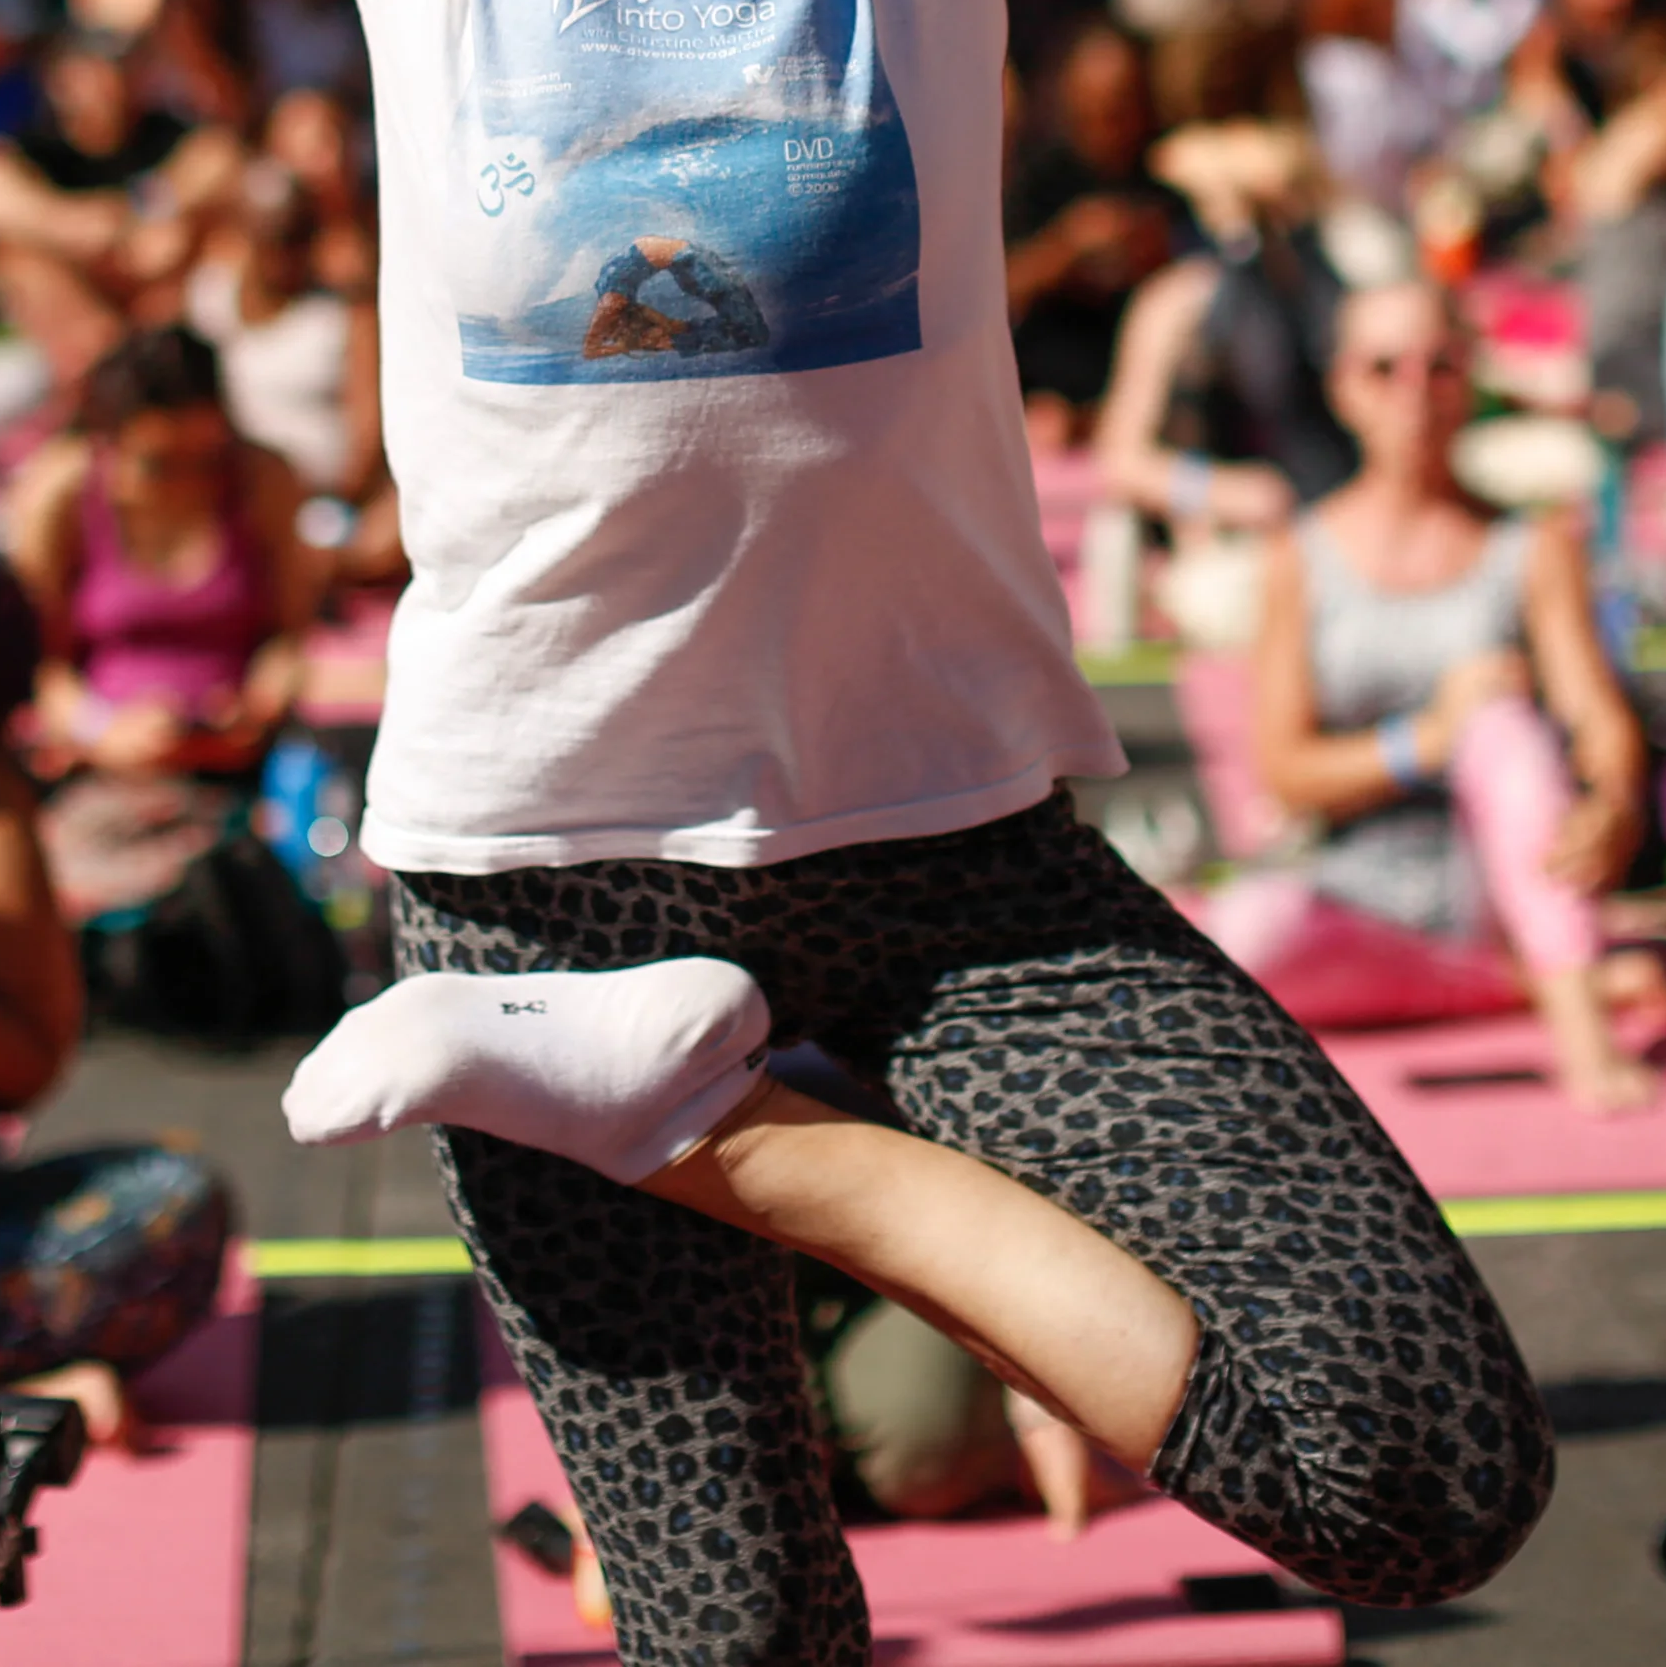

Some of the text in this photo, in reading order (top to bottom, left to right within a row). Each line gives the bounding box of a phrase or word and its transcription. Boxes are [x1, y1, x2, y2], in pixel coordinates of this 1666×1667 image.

[616, 0, 776, 32] into Yoga
[580, 34, 776, 61] www.diveintoyoga.com
[784, 137, 833, 162] DVD
